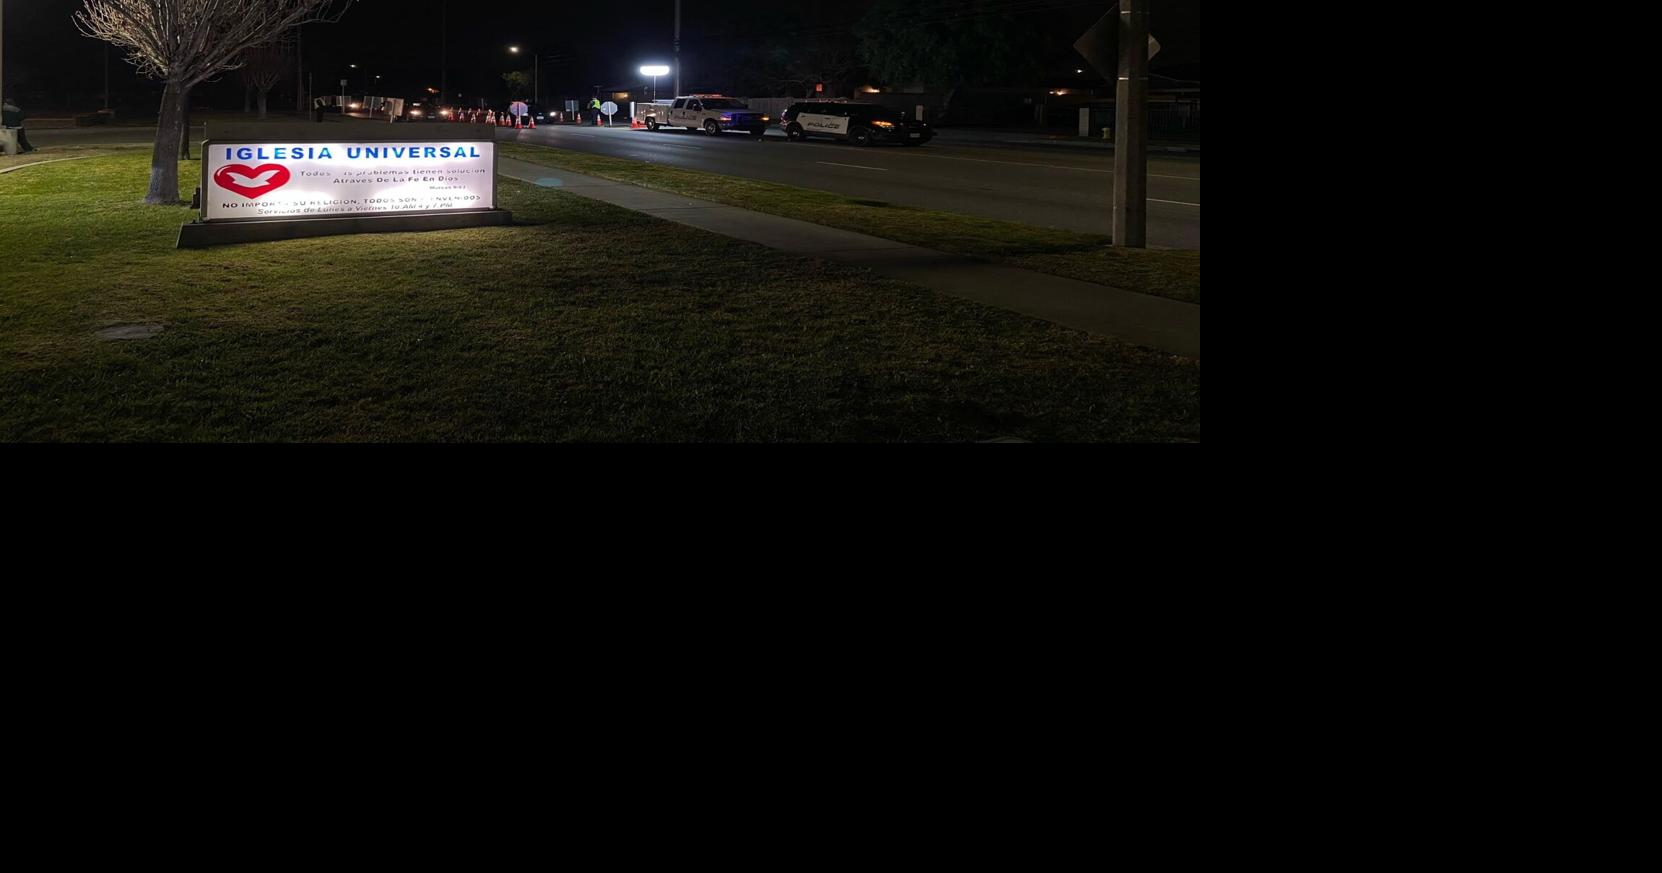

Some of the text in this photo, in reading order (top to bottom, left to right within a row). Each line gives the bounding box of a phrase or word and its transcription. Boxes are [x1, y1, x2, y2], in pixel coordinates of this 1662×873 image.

[807, 121, 840, 130] POLICE
[226, 146, 480, 160] IGLESIA UNIVERSAL
